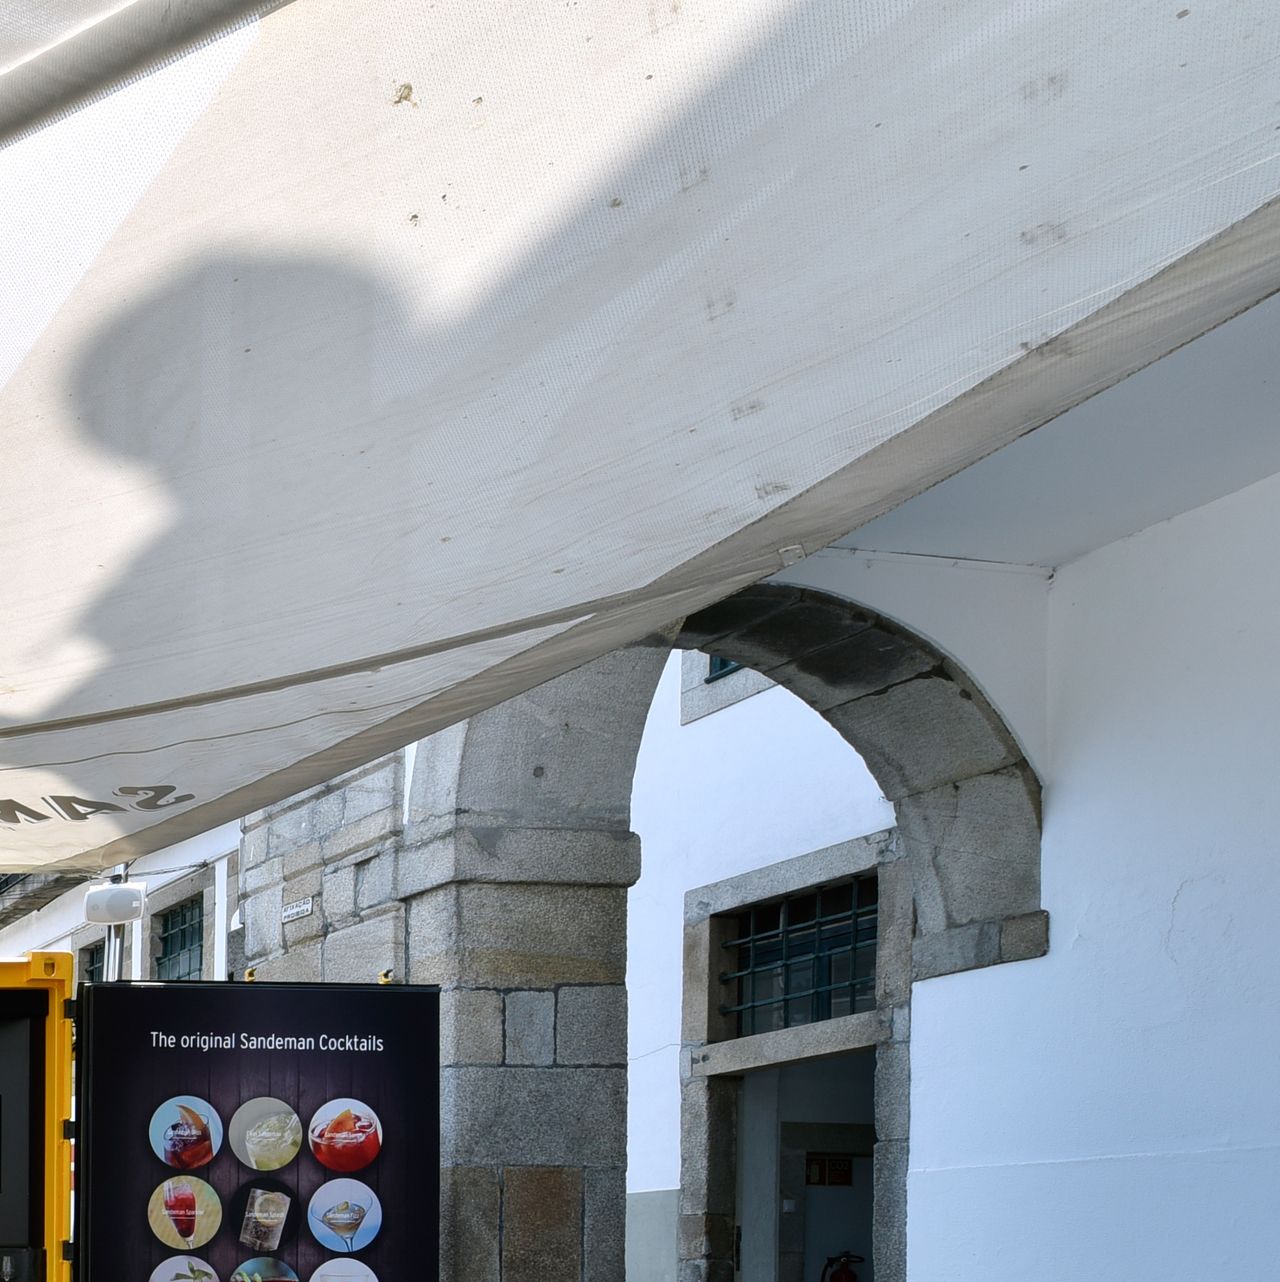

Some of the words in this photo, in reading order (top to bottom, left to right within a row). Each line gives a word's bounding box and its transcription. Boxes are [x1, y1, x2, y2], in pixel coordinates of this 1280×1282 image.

[150, 1031, 176, 1048] The
[180, 1032, 235, 1052] original
[240, 1033, 315, 1050] Sandeman
[318, 1034, 384, 1051] Cocktails
